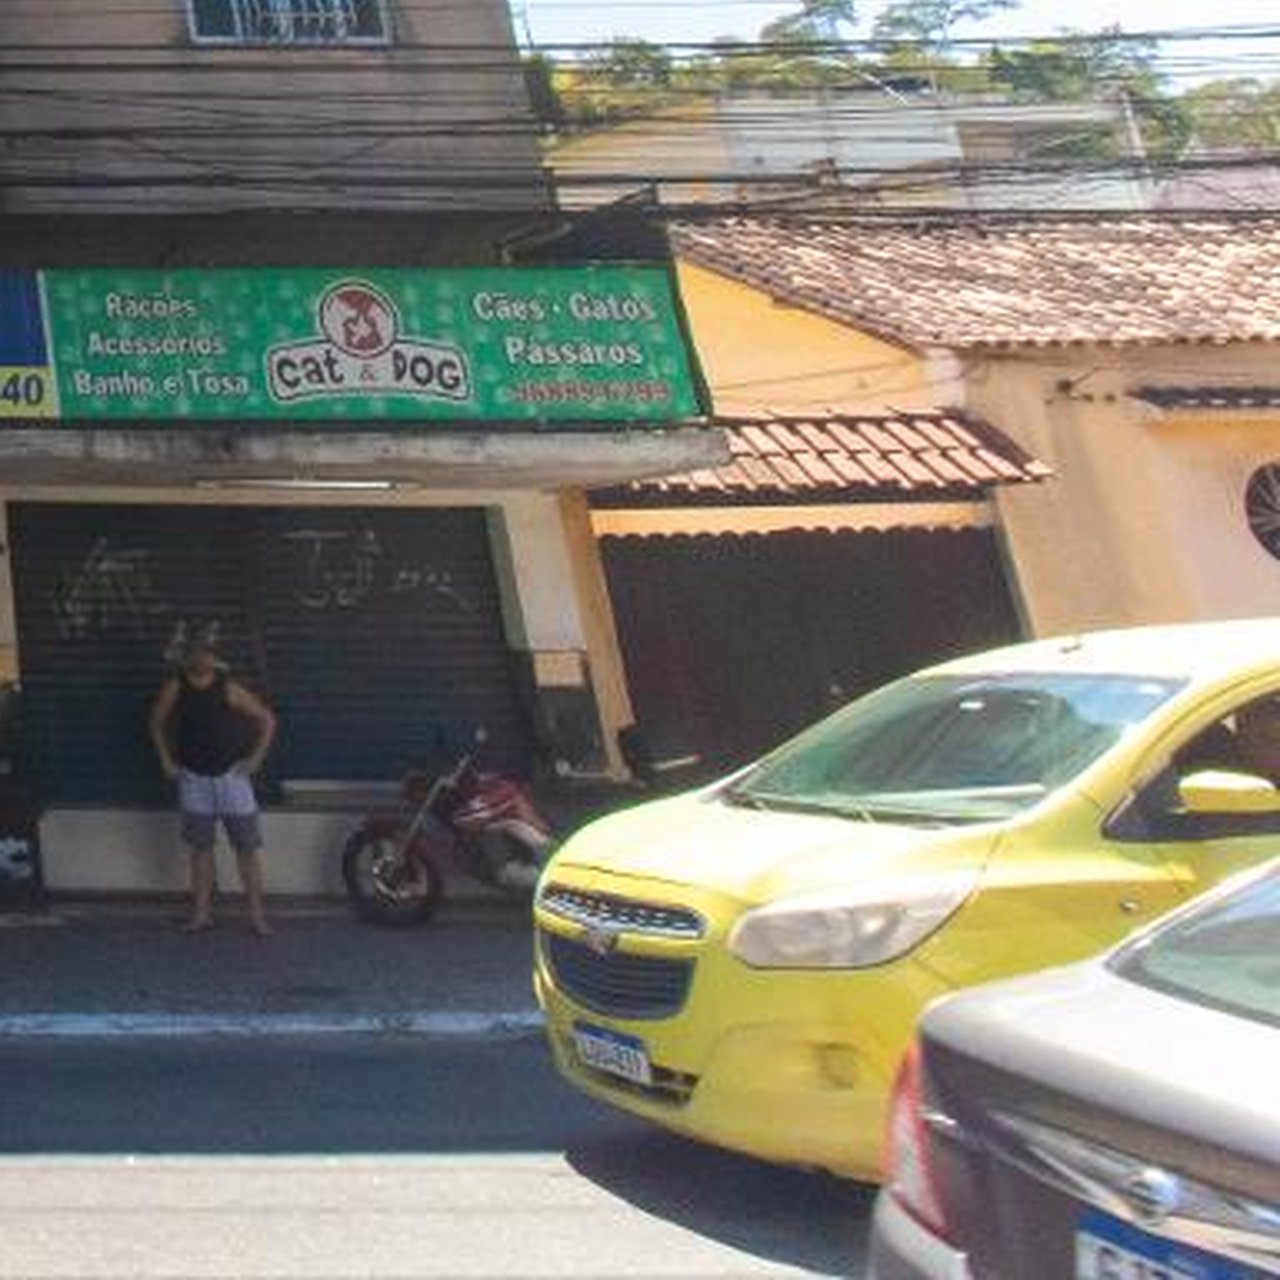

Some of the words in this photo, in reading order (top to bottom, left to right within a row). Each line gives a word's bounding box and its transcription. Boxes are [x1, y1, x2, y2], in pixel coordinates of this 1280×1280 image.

[473, 291, 544, 320] Cães
[569, 291, 656, 321] Gatos
[74, 370, 154, 395] Banho
[188, 370, 249, 395] Tosa
